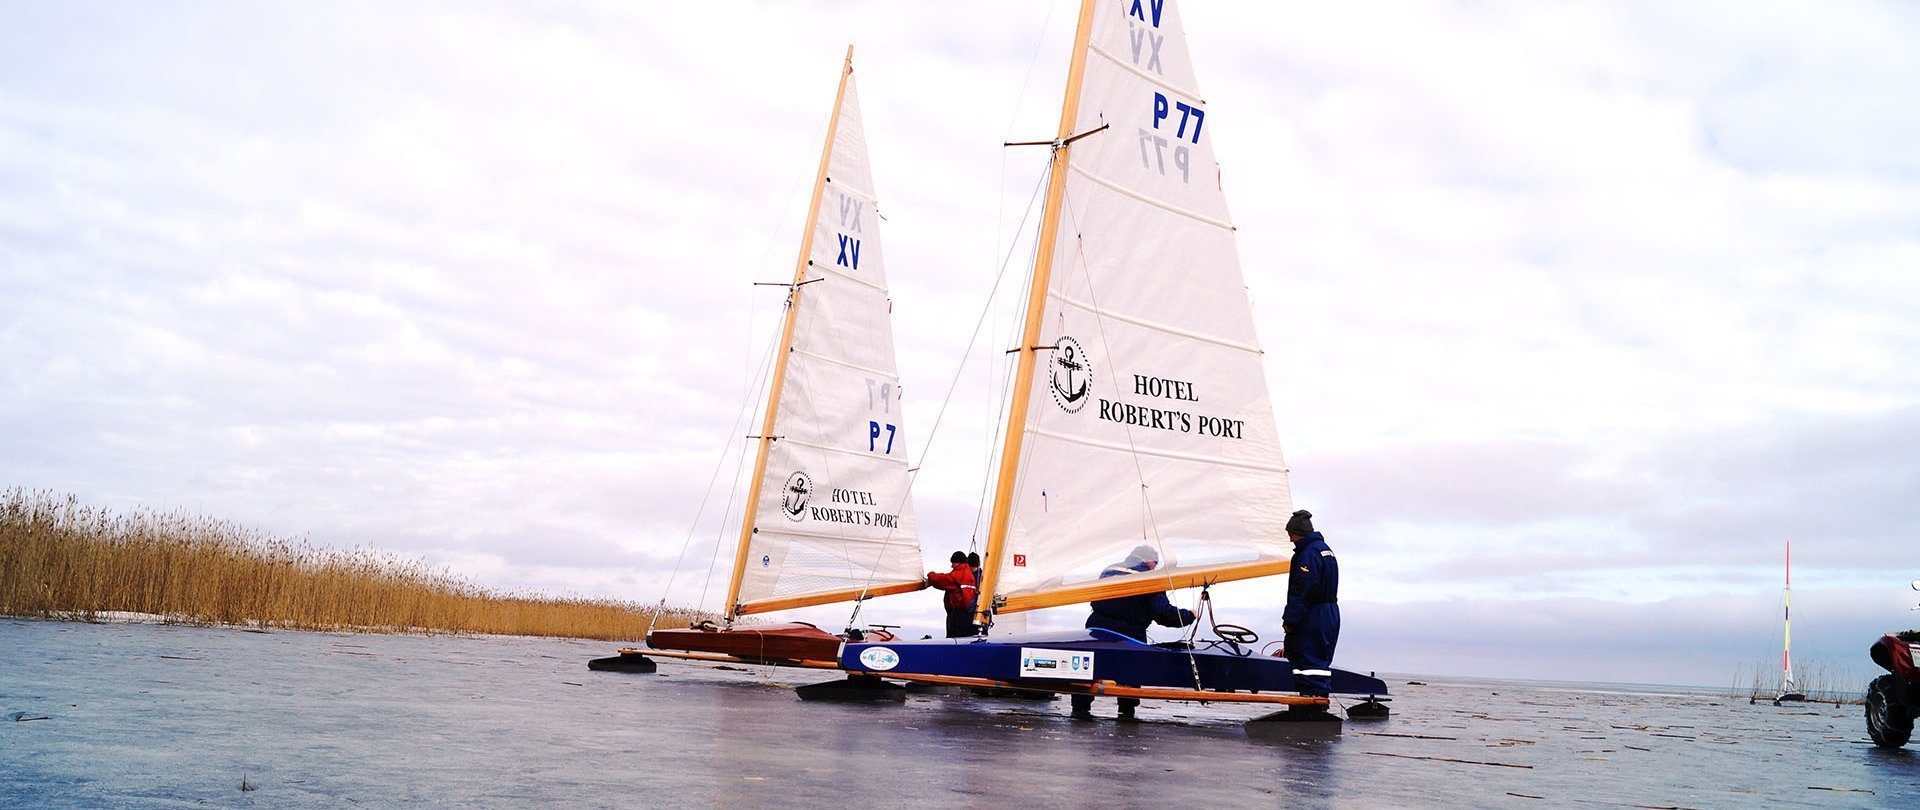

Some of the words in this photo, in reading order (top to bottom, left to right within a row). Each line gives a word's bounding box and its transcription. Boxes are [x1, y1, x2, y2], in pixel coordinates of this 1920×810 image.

[1129, 0, 1164, 29] XV
[1176, 101, 1205, 144] 77
[837, 232, 861, 270] XV
[1134, 374, 1199, 402] HOTEL
[1099, 398, 1191, 433] ROBERT'S
[1198, 415, 1244, 439] PORT
[832, 488, 877, 506] HOTEL
[811, 506, 871, 526] ROBERT'S
[874, 512, 899, 529] PORT
